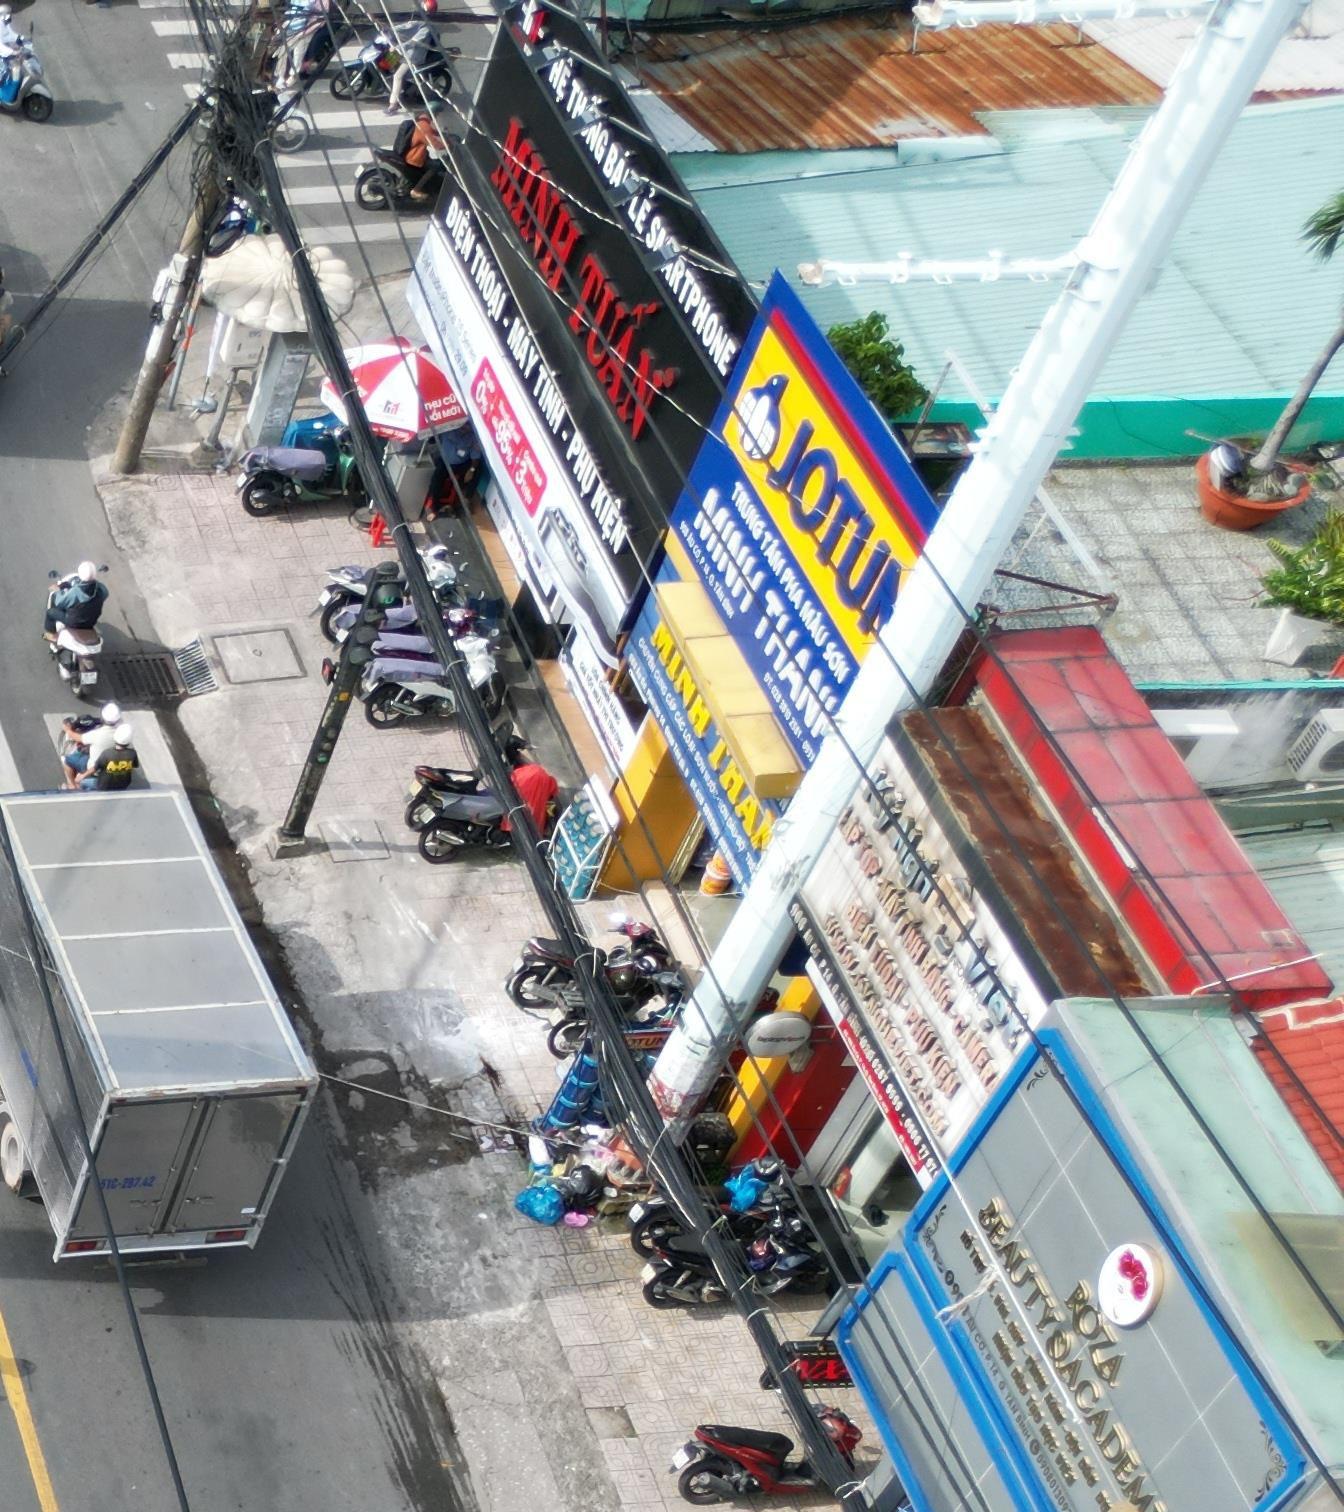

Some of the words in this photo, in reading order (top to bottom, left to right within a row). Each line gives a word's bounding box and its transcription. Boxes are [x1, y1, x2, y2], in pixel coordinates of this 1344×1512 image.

[491, 117, 584, 293] MINH
[445, 197, 479, 263] ĐIỆN
[469, 246, 506, 323] THOẠI
[533, 368, 567, 435] TÍNH
[566, 432, 599, 497] PHỤ
[590, 481, 629, 555] KIỆN
[690, 484, 767, 613] MINH
[728, 480, 765, 541] TRUNG
[757, 528, 786, 577] TÂM
[778, 565, 806, 612] PHA
[651, 620, 712, 739] MINH
[978, 1198, 1066, 1332] BEAUTY
